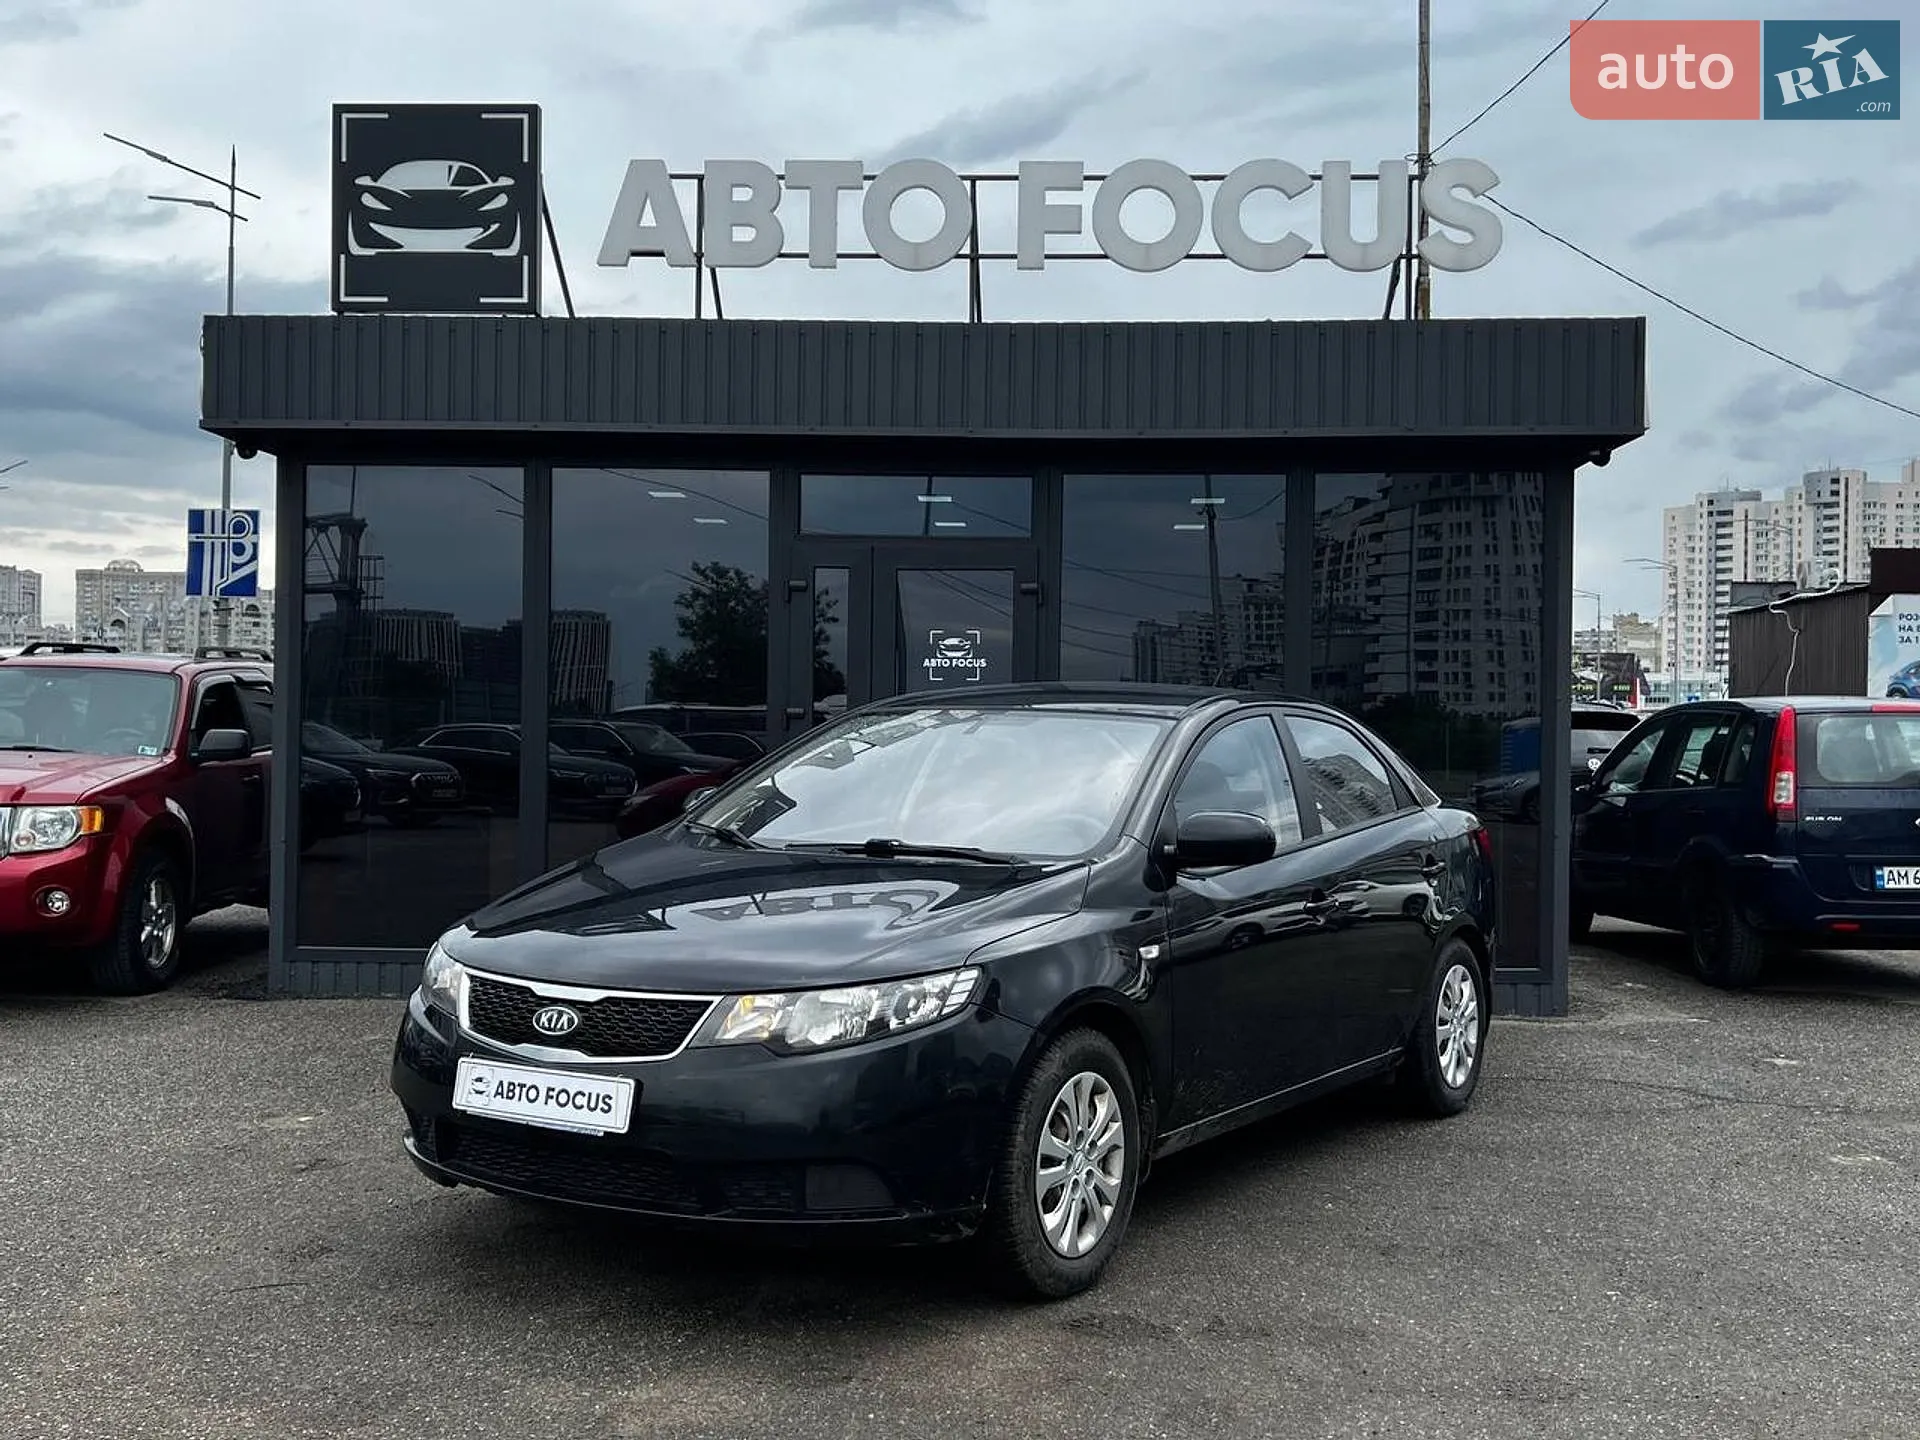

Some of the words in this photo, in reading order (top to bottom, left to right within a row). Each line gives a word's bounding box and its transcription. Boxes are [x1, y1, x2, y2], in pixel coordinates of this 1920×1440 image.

[597, 158, 972, 271] АВТО
[1016, 158, 1503, 272] FOCUS
[1898, 612, 1920, 621] РОЗ
[923, 658, 951, 668] АВТО
[952, 658, 987, 668] FOCUS
[1886, 869, 1909, 885] AM
[539, 1010, 569, 1030] KIA
[493, 1080, 540, 1104] АВТО
[544, 1086, 613, 1114] FOCUS
